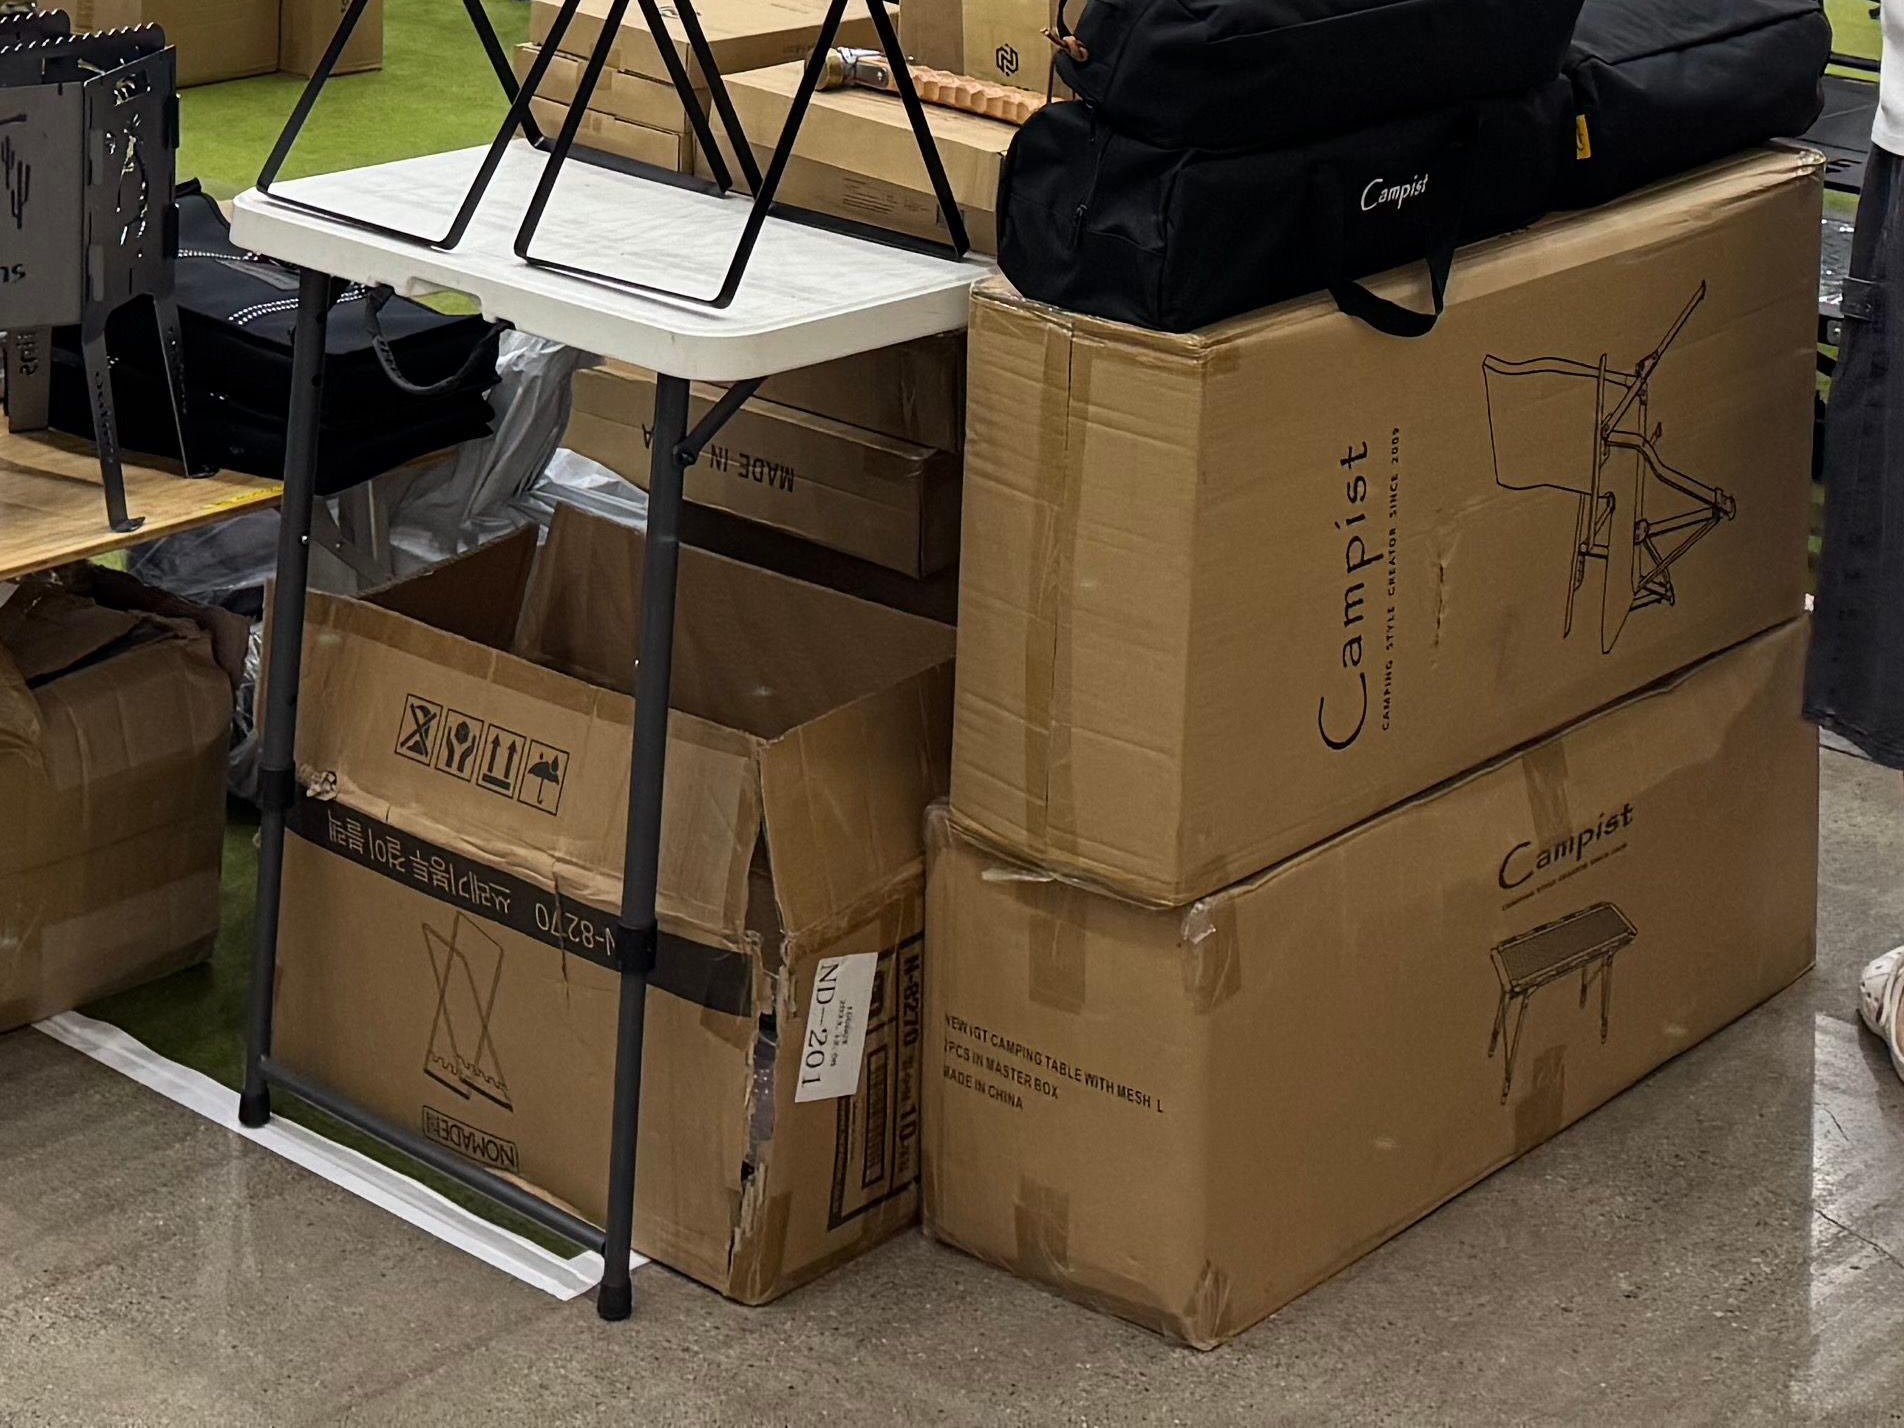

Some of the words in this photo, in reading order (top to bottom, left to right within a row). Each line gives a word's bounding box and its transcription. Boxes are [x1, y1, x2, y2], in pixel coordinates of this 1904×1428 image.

[1360, 173, 1429, 212] Campist
[709, 445, 729, 474] IN
[738, 452, 795, 493] MADE
[1389, 472, 1398, 520] SINCE
[1388, 528, 1397, 597] CREATOR
[1318, 441, 1385, 751] Campist
[1386, 606, 1396, 650] STYLE
[1382, 659, 1394, 732] CAMPING
[328, 809, 365, 855] 블랙
[368, 828, 406, 873] 걸이
[1498, 802, 1634, 890] Campist
[408, 849, 512, 914] 쓰레기봉투
[902, 955, 919, 1046] N-8270
[972, 1053, 984, 1068] IN
[985, 1056, 1032, 1088] MASTER
[1033, 1077, 1059, 1100] BOX
[974, 1076, 986, 1094] IN
[987, 1084, 1024, 1111] CHINA
[990, 1033, 1044, 1067] CAMPING
[1045, 1054, 1082, 1082] TABLE
[1083, 1070, 1115, 1095] WITH
[1116, 1084, 1151, 1109] MESH
[1156, 1098, 1164, 1114] L
